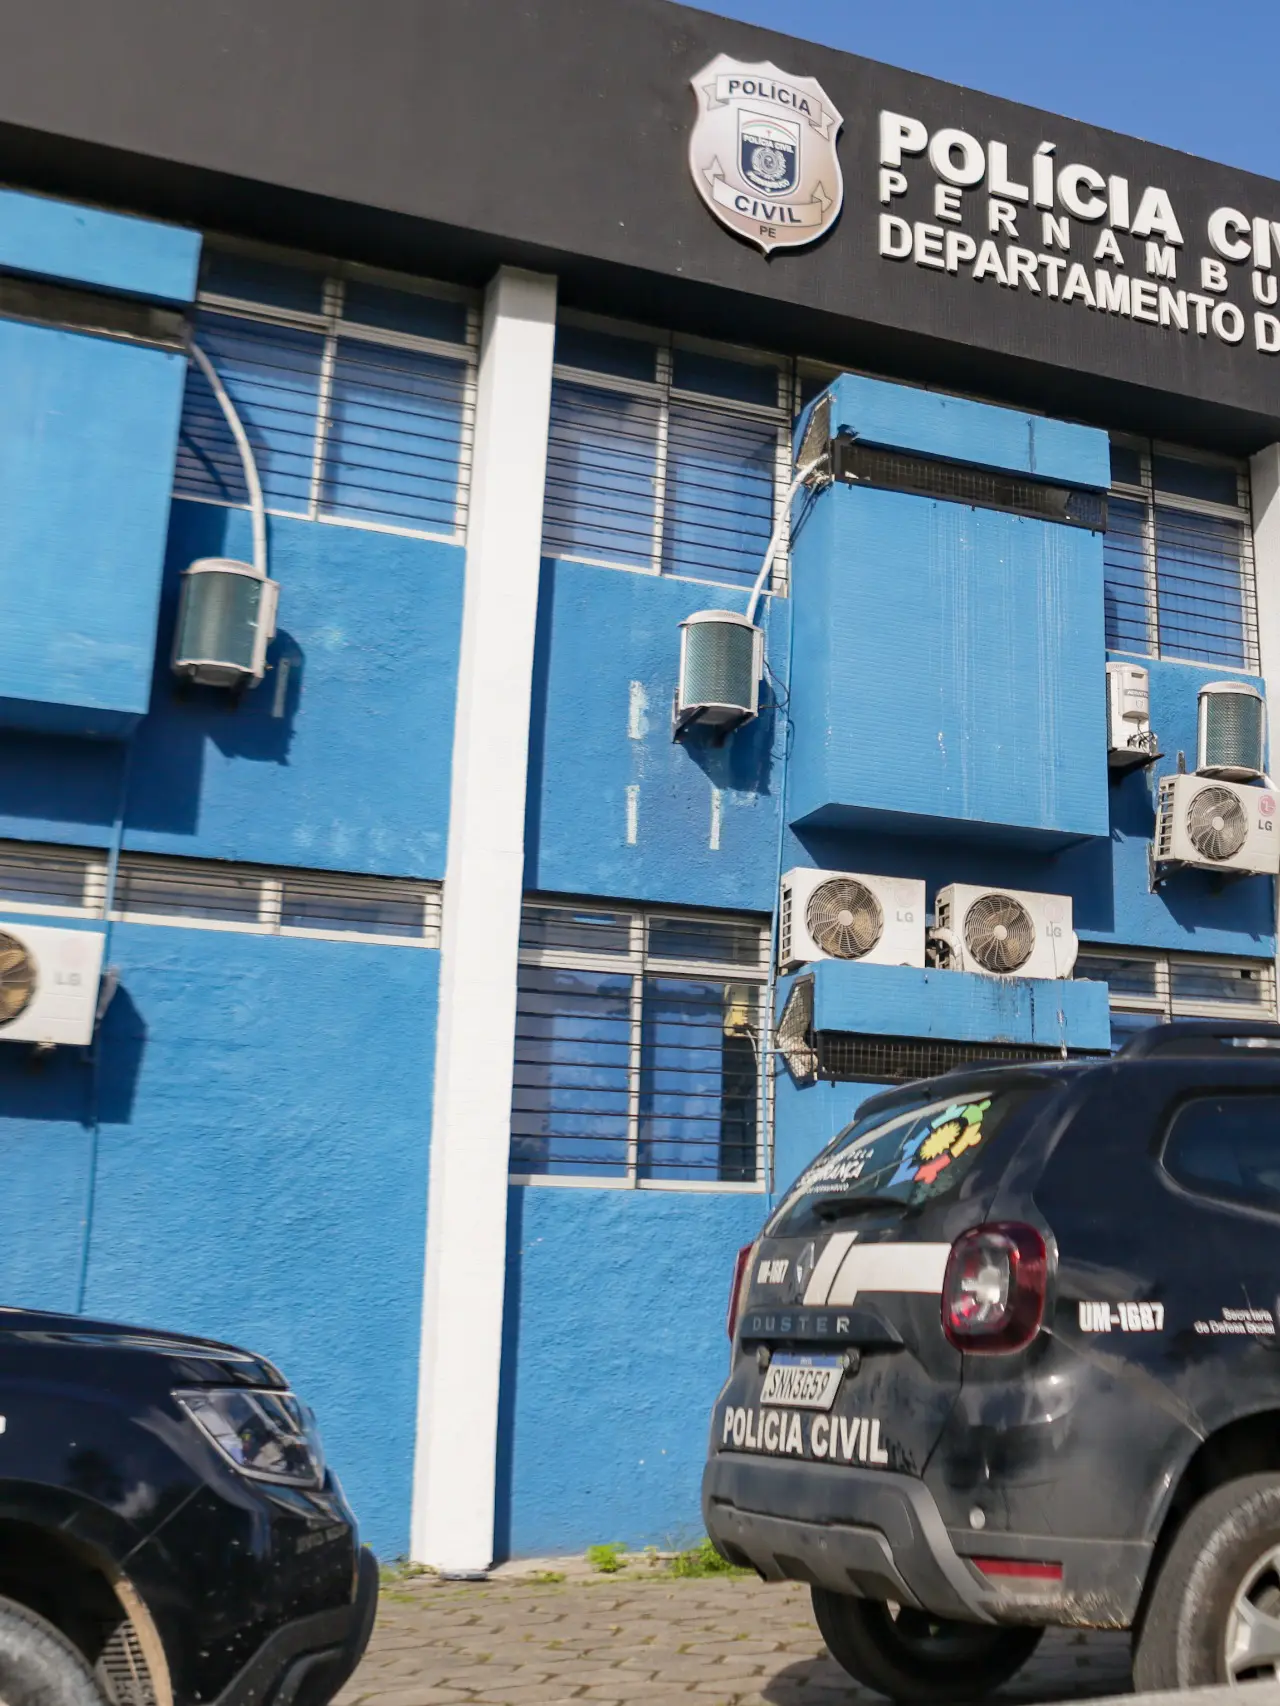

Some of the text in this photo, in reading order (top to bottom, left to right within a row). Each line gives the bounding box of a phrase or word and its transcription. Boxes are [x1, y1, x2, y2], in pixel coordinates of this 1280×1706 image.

[728, 80, 812, 116] POLÍCIA
[879, 110, 1184, 246] POLÍCIA
[734, 195, 802, 223] CIVIL
[759, 226, 776, 238] PE
[879, 212, 1246, 345] DEPARTAMENTO
[1258, 819, 1273, 832] LG
[896, 910, 914, 923] LG
[1045, 925, 1062, 938] LG
[55, 972, 83, 986] LG
[1222, 1307, 1273, 1322] Secretaria
[752, 1315, 850, 1334] DUSTER
[1194, 1320, 1275, 1335] de Defesa Social
[811, 1414, 889, 1464] CIVIL
